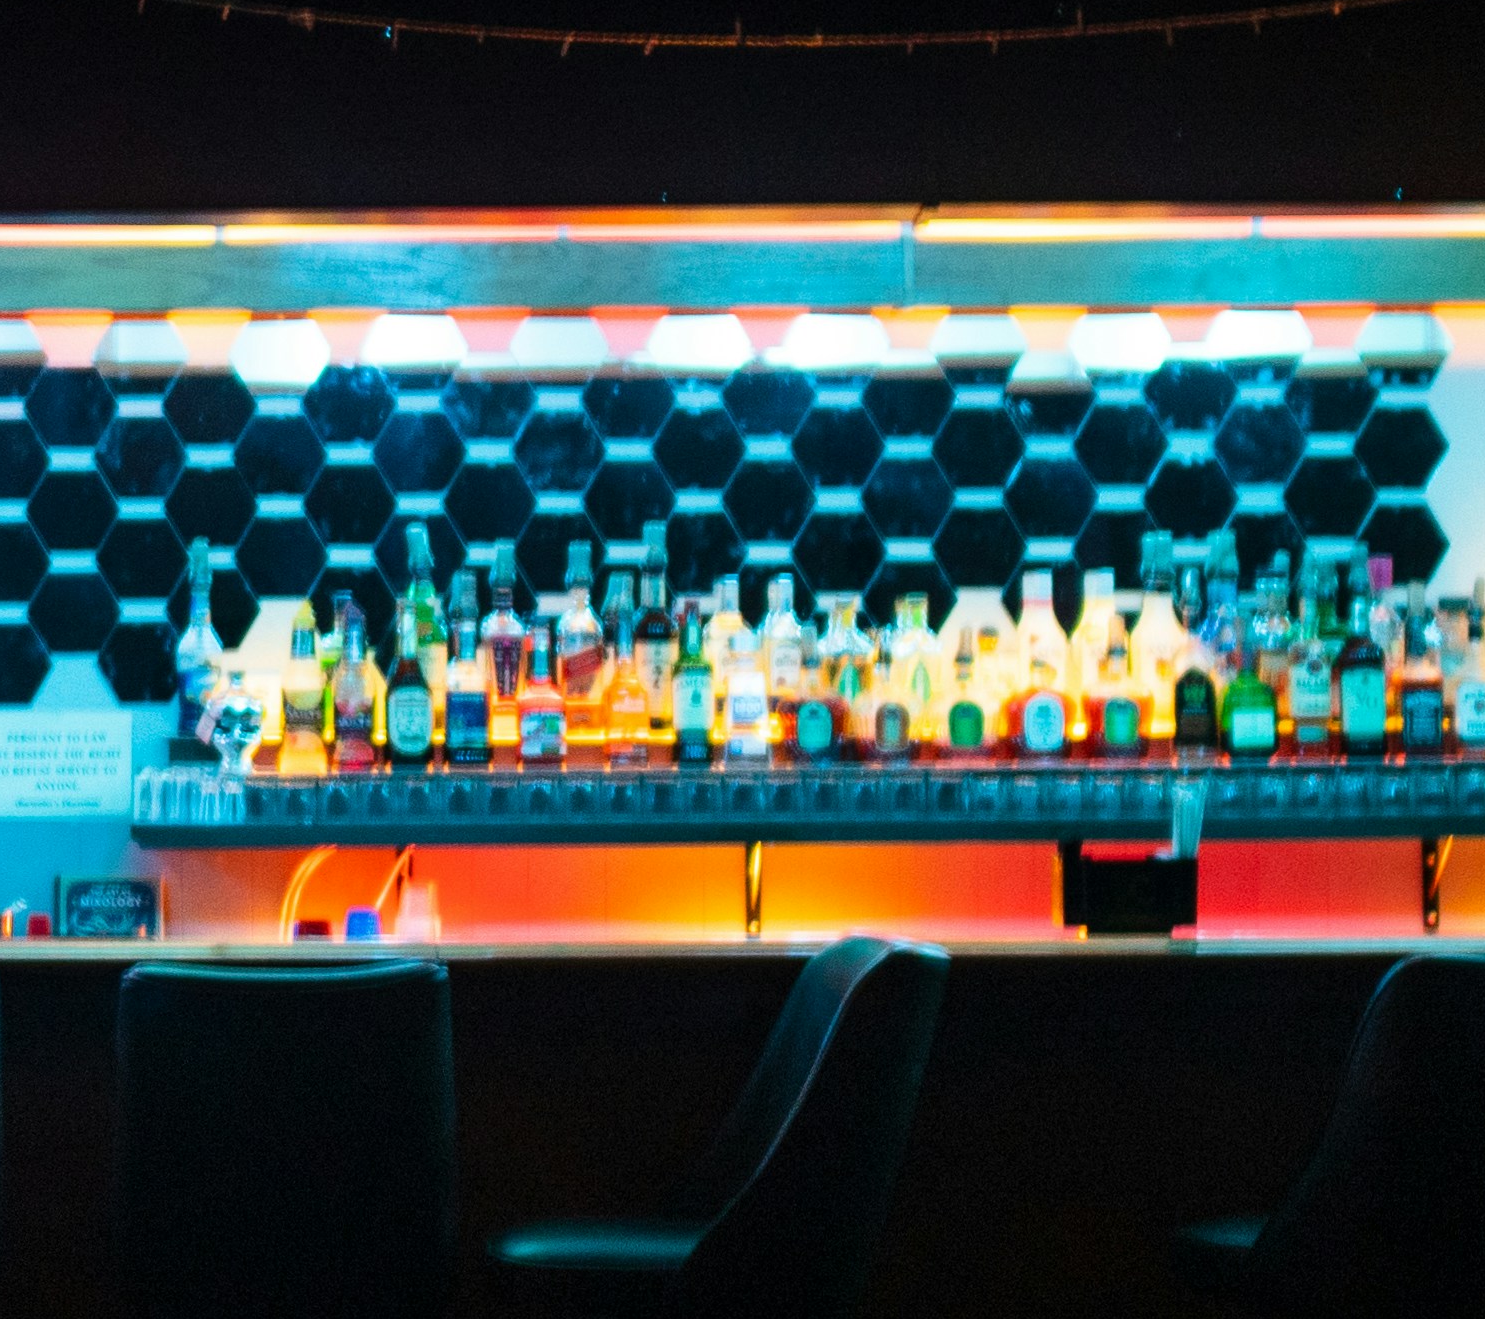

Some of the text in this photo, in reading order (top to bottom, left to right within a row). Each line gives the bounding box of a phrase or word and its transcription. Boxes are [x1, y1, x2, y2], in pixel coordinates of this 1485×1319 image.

[13, 749, 59, 759] RESERVE
[12, 765, 51, 776] REFUSE
[55, 765, 98, 776] SERVICE
